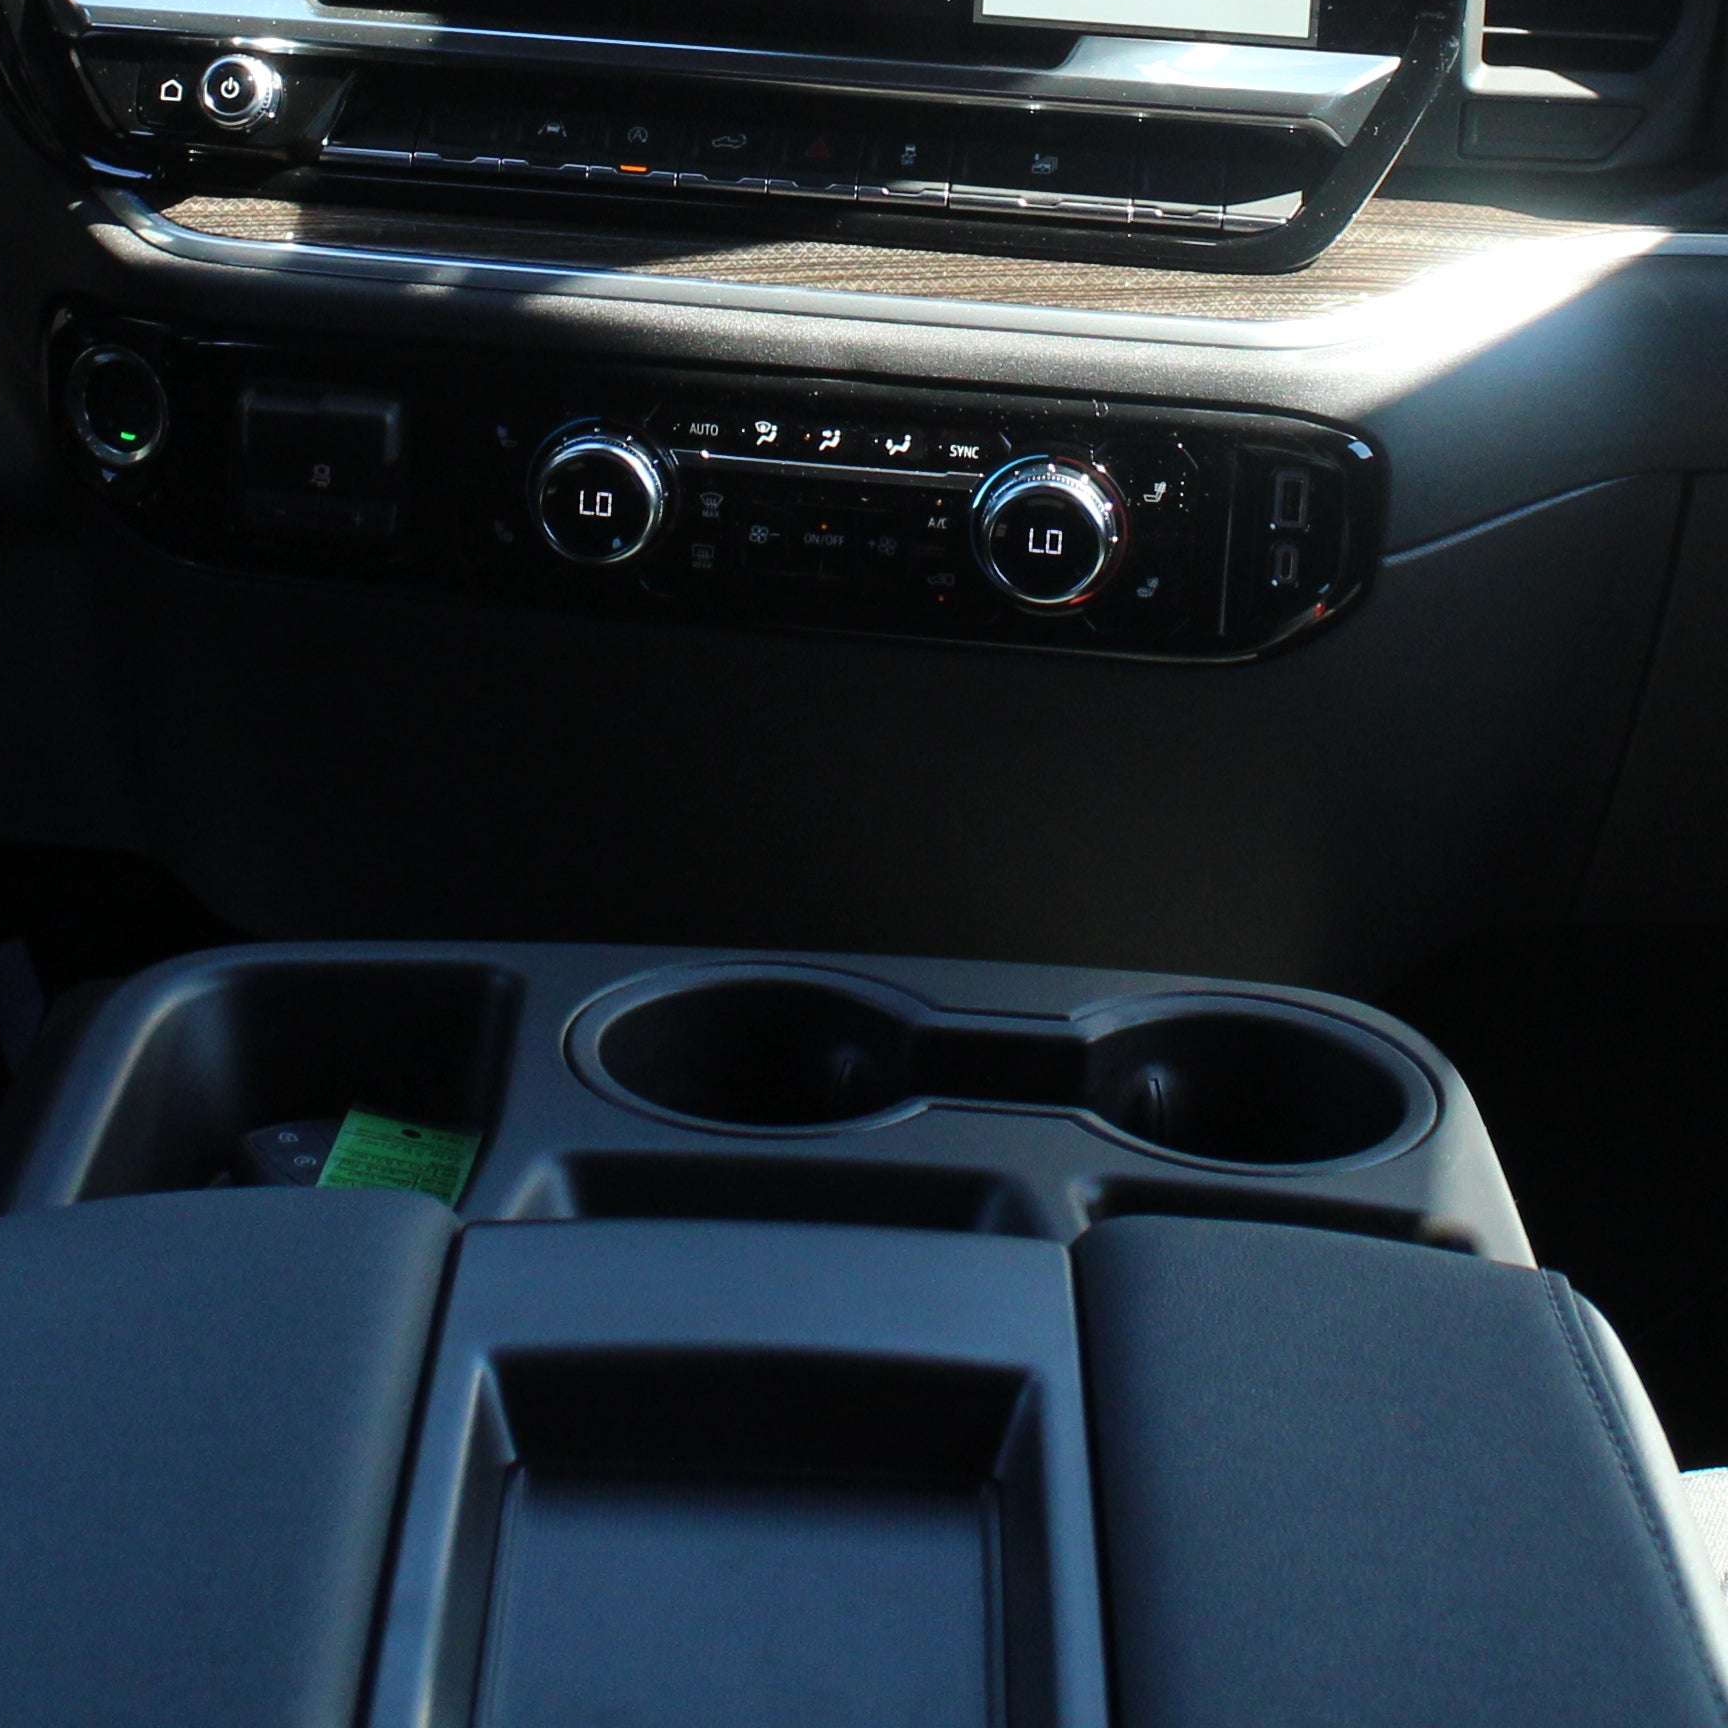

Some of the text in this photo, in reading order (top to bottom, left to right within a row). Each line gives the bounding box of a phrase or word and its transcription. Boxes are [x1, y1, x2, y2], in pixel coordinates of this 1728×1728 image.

[689, 423, 719, 437] AUTO
[949, 444, 980, 459] SYNC
[927, 516, 948, 530] A/C
[803, 533, 846, 547] ON/OFF
